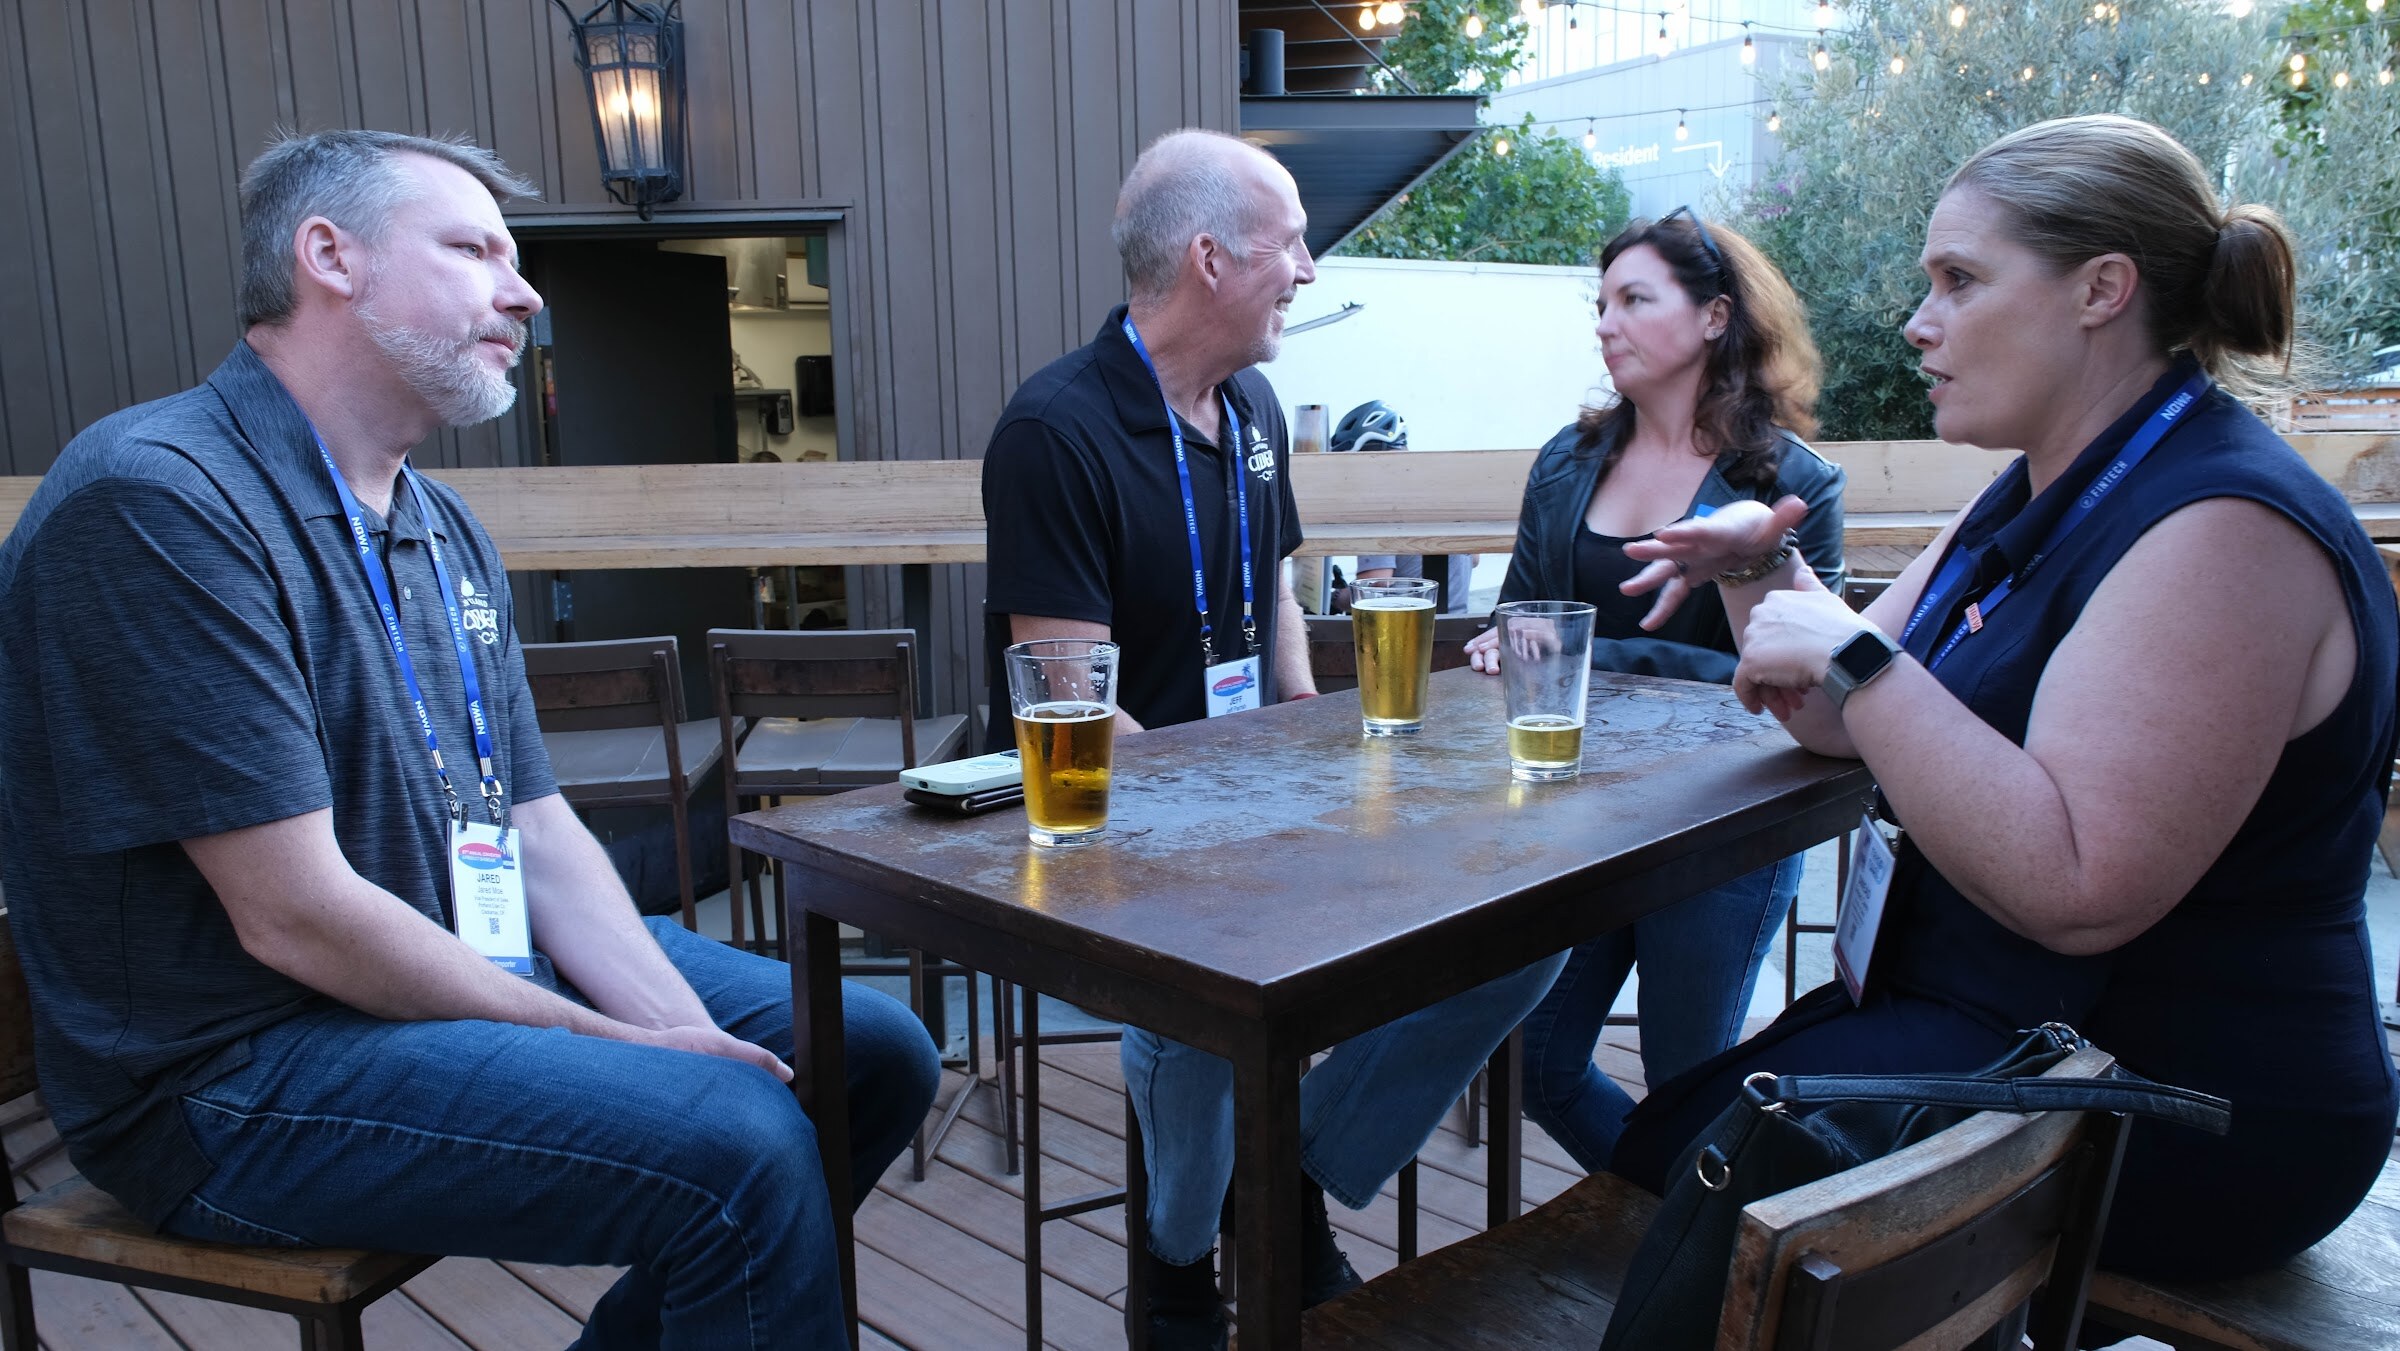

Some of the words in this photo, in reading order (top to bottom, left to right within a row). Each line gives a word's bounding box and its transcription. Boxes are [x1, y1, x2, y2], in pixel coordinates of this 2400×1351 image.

[1592, 143, 1660, 169] Resident
[2160, 392, 2194, 420] NDWA
[1174, 435, 1184, 462] NDWA
[2090, 461, 2128, 497] FINTECH
[351, 516, 370, 555] NDWA
[1194, 570, 1204, 597] NDWA
[387, 616, 404, 653] FINTECH
[450, 606, 464, 640] FINTECH
[415, 700, 432, 737] NDWA
[470, 700, 486, 735] NDWA
[477, 873, 501, 884] JARED
